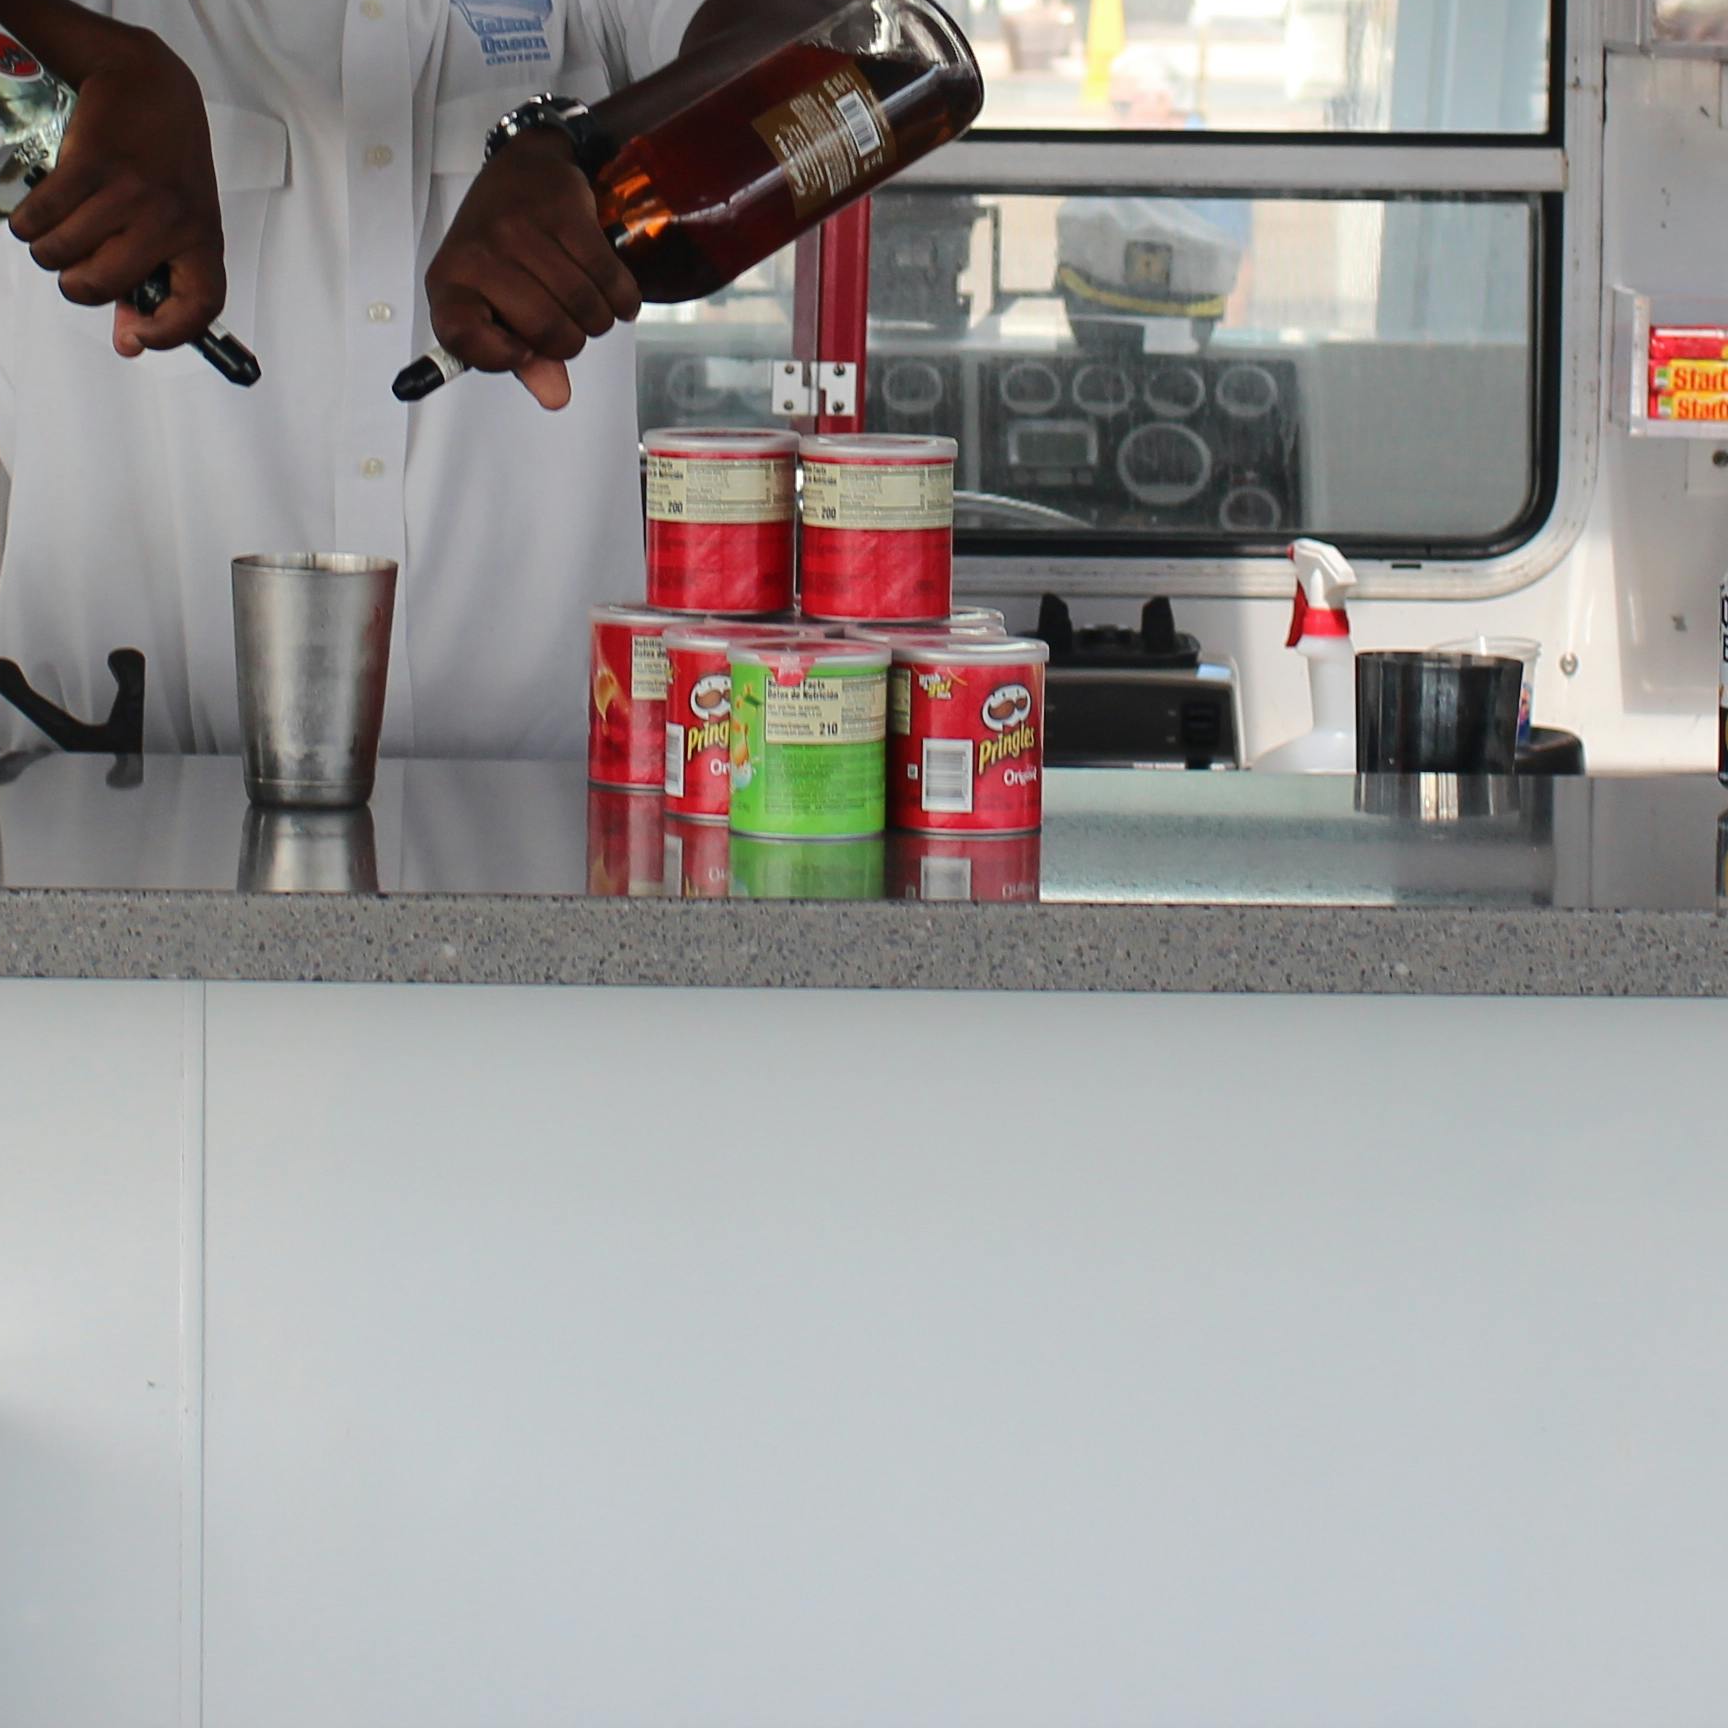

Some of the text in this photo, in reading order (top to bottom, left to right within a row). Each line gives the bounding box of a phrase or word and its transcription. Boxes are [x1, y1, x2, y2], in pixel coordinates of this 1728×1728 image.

[481, 35, 549, 54] Queen
[688, 721, 730, 761] Pring
[819, 722, 838, 736] 210
[978, 722, 1035, 775] Pringles
